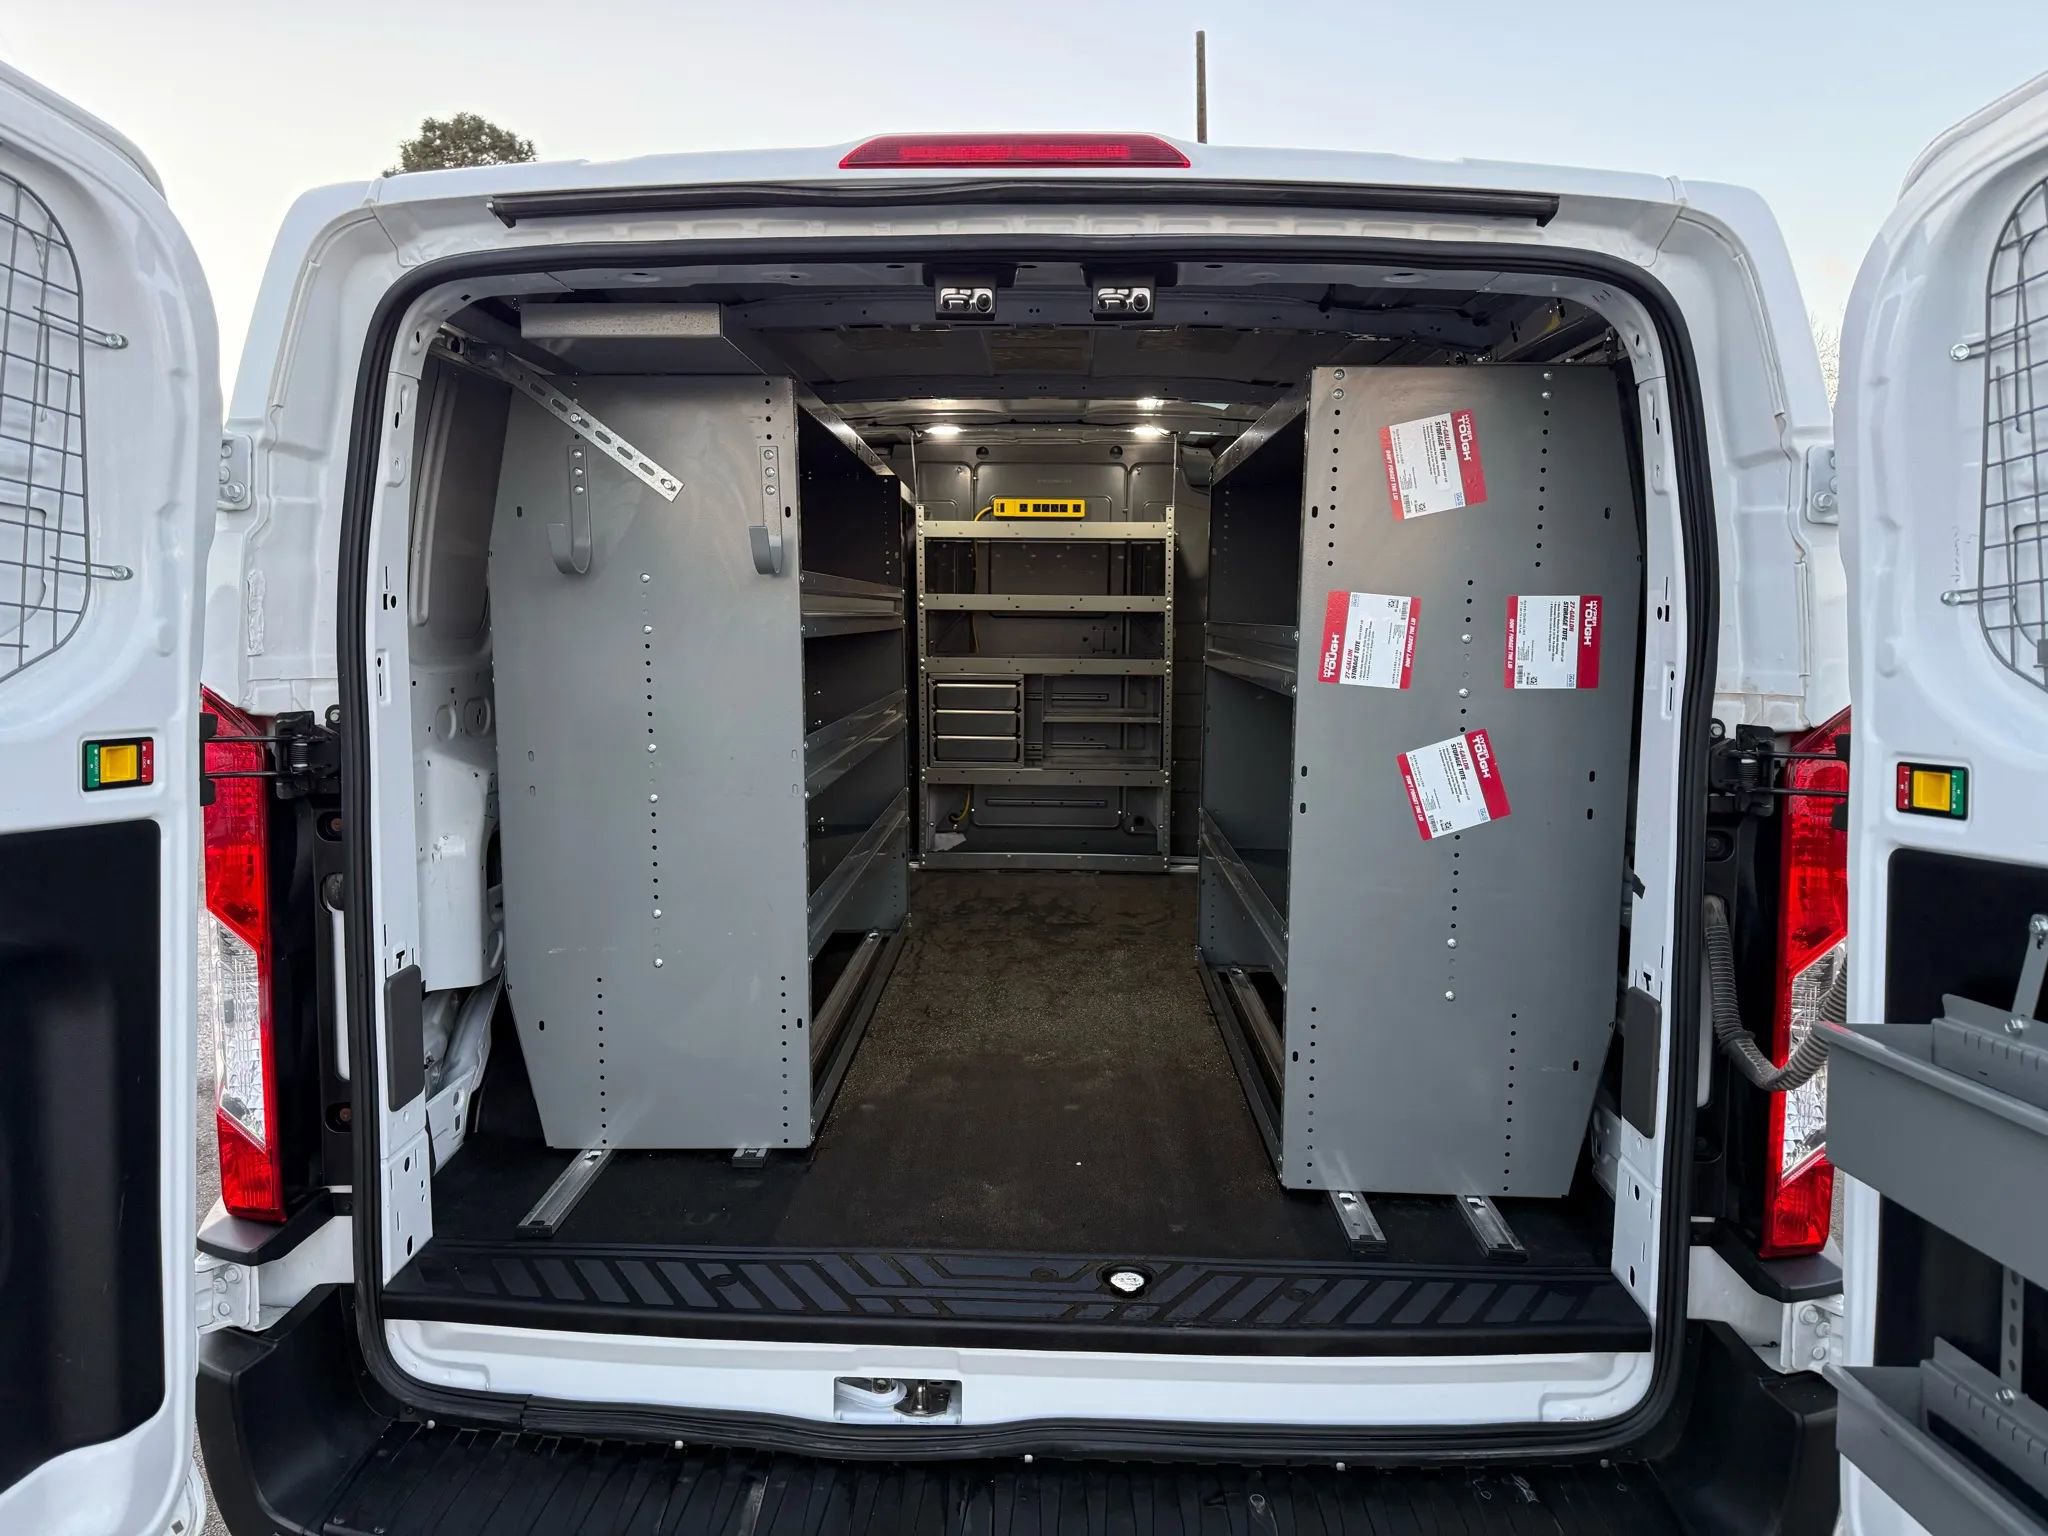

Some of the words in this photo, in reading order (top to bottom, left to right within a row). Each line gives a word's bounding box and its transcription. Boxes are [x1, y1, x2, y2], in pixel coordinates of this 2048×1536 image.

[1434, 421, 1444, 447] STORAGE
[1441, 420, 1452, 451] 27-GALLON
[1456, 415, 1472, 461] TOUGH
[1464, 414, 1473, 440] HYPER
[1388, 464, 1396, 483] FORGET
[1584, 601, 1593, 645] TOUGH
[1328, 634, 1339, 677] TOUGH
[1344, 649, 1353, 679] 27-GALLON
[1456, 741, 1470, 771] 27-GALLON
[1471, 736, 1491, 778] TOUGH
[1478, 734, 1490, 759] HYPER
[1451, 743, 1462, 767] STORAGE
[1458, 768, 1466, 781] TOTE
[1409, 788, 1419, 806] FORGET
